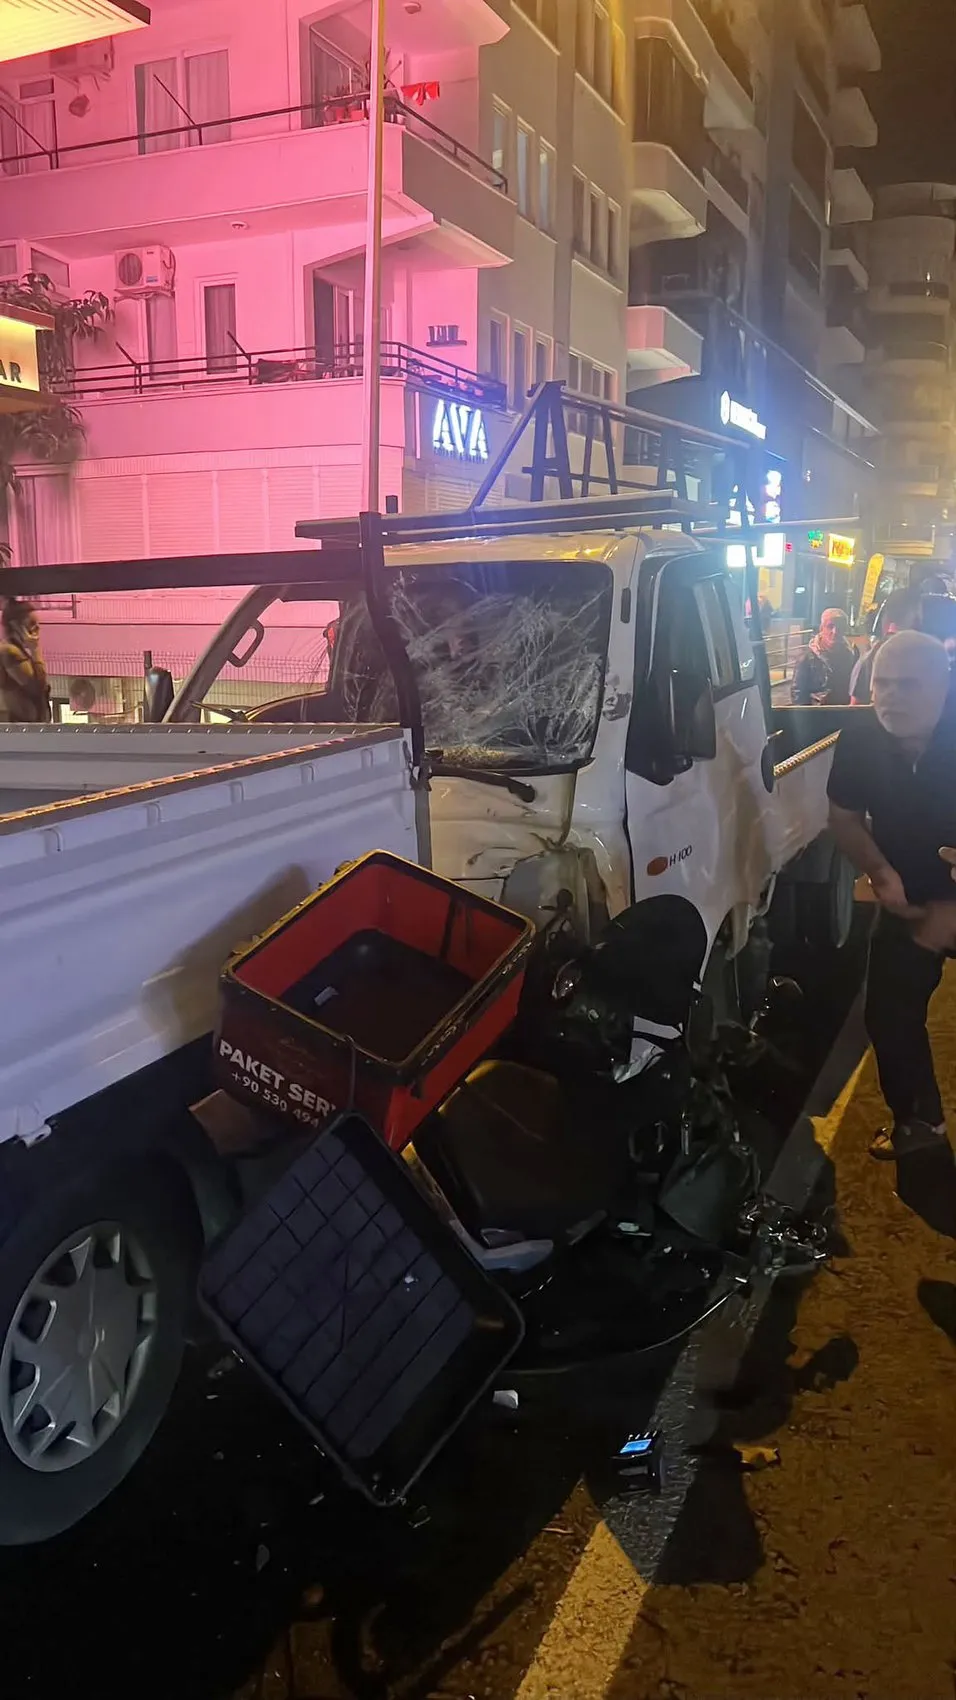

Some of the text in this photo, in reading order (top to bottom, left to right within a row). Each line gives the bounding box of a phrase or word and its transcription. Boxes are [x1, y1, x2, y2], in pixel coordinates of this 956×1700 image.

[432, 399, 488, 459] AVA
[219, 1039, 336, 1117] PAKET SER
[231, 1071, 259, 1093] +90
[263, 1090, 288, 1112] 530
